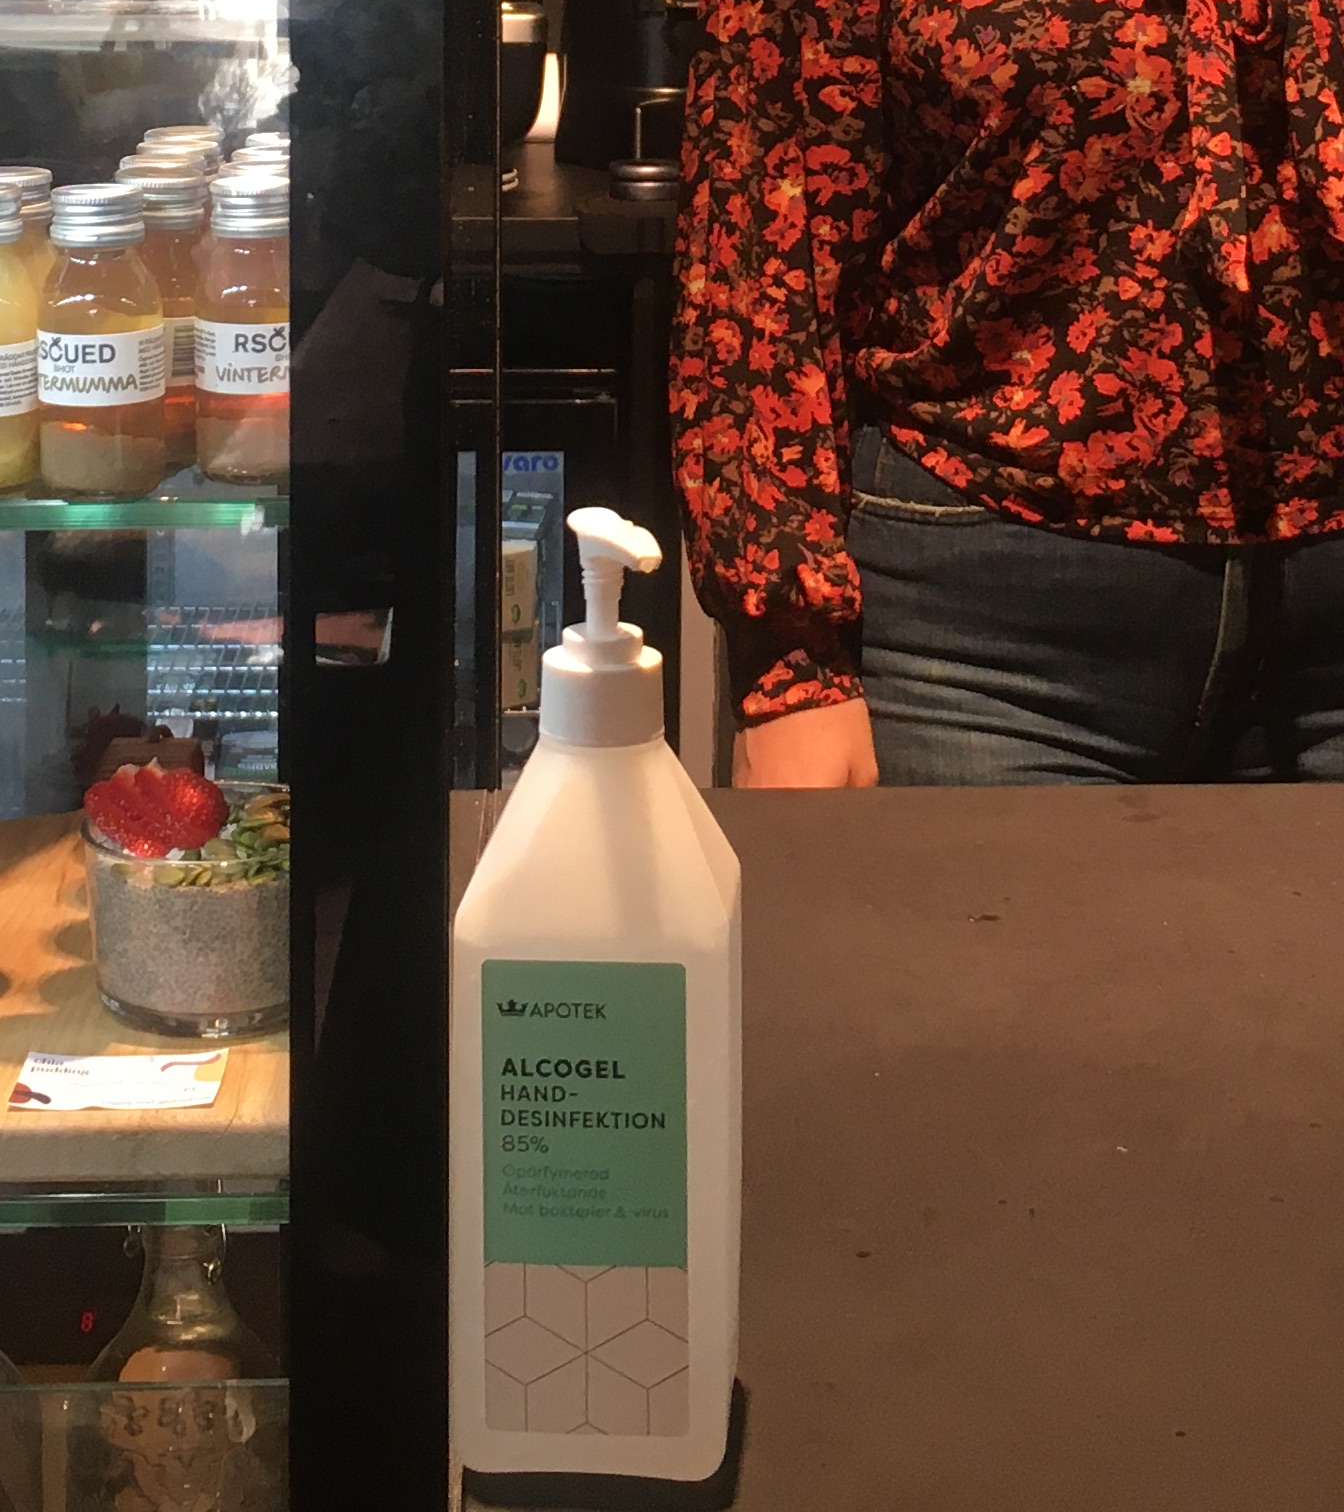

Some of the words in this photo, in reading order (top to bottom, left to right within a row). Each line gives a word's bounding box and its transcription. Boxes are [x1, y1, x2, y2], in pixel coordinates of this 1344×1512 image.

[529, 1002, 607, 1020] APOTEK
[501, 1057, 626, 1080] ALCOGEL
[500, 1084, 579, 1103] HAND-
[500, 1109, 666, 1130] DESINFEKTION
[501, 1135, 550, 1154] 85%
[502, 1163, 610, 1182] Oparfymerad
